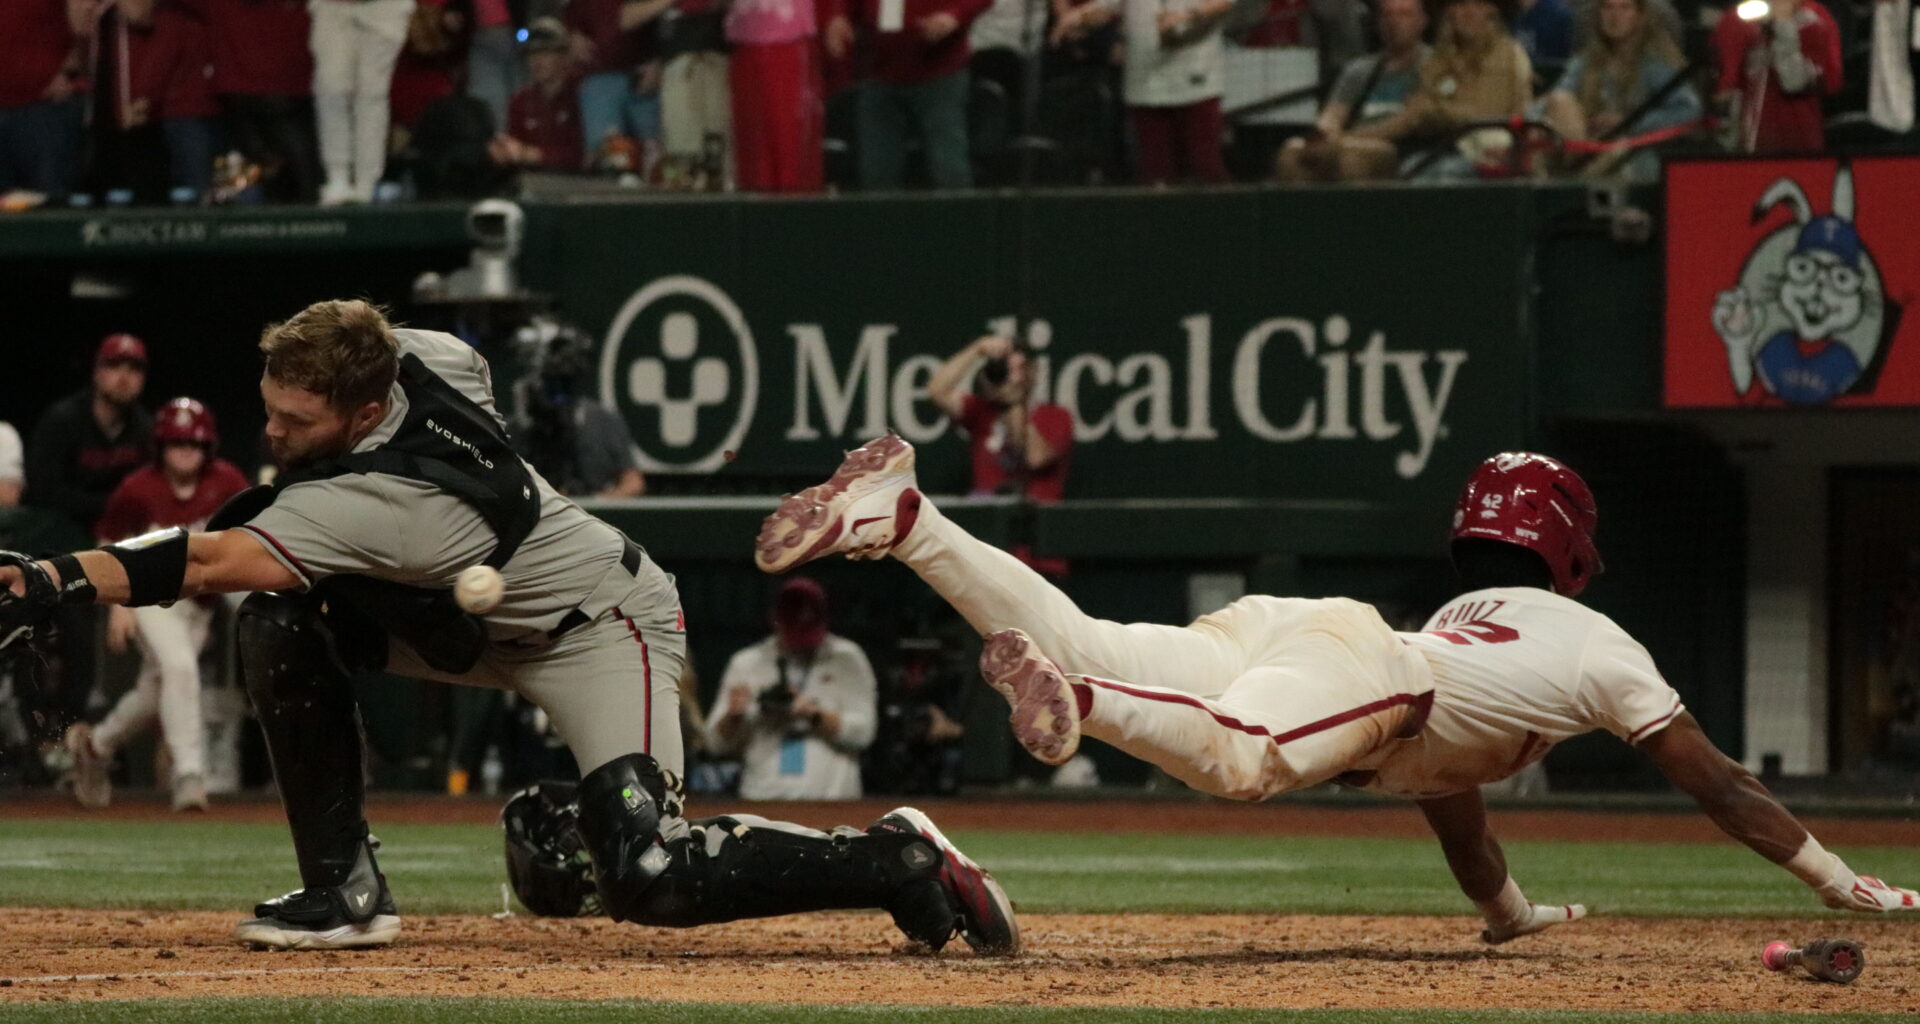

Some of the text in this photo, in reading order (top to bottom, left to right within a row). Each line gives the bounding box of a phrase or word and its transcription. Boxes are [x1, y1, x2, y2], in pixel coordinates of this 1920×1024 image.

[786, 313, 1468, 478] Meical City
[1480, 493, 1504, 510] 42
[1434, 600, 1507, 630] RUIZ
